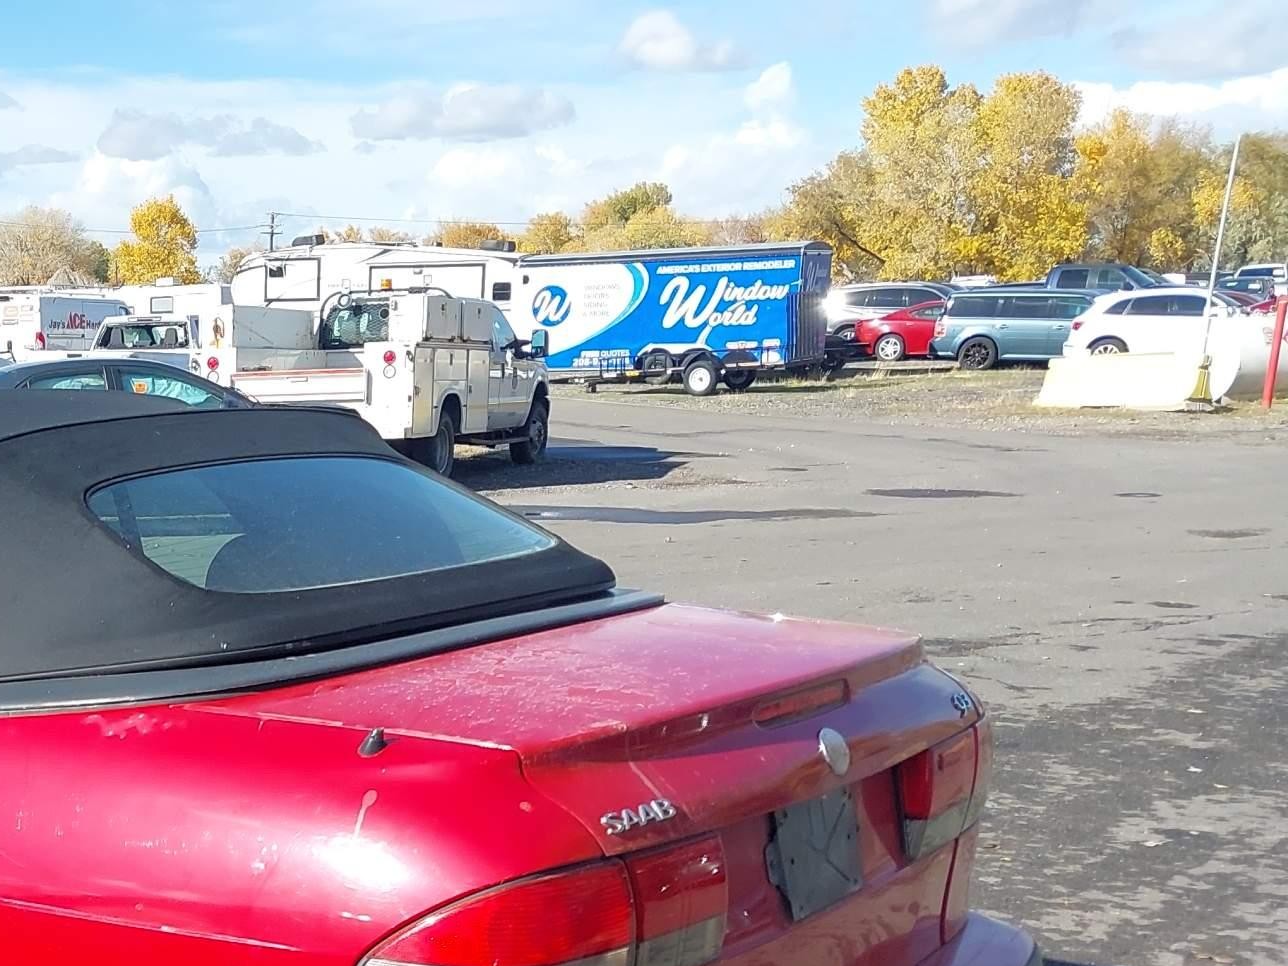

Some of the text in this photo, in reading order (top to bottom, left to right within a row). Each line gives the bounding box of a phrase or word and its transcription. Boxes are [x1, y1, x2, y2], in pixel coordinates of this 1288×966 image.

[657, 260, 795, 274] AMERICA'S EXTERIOR REMODELER
[659, 275, 790, 329] Window
[48, 319, 65, 330] Jay's
[66, 311, 86, 329] ACE
[600, 349, 630, 358] QUOTES
[599, 798, 677, 836] SAAB
